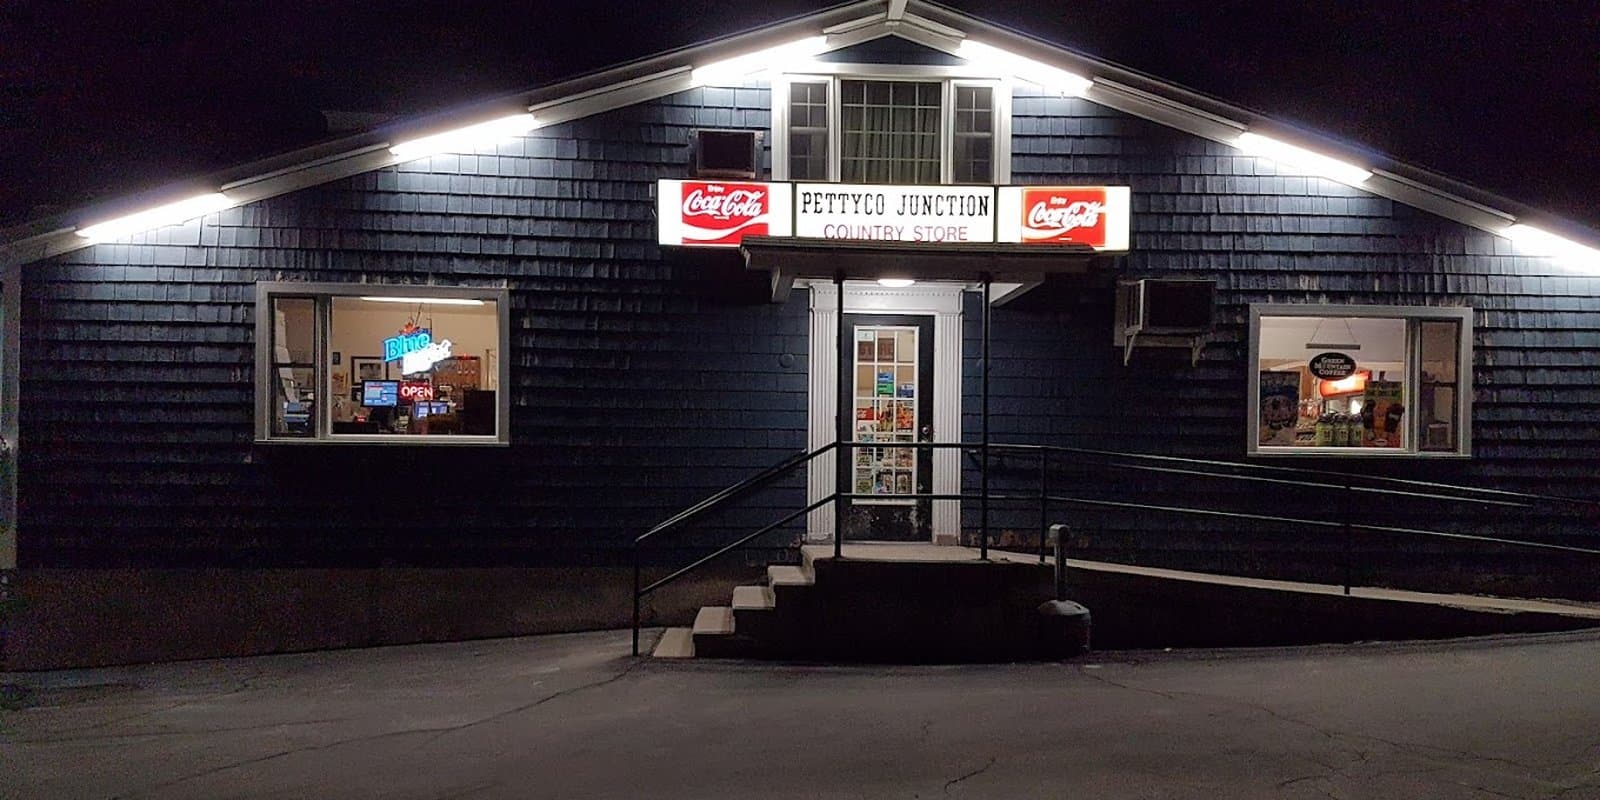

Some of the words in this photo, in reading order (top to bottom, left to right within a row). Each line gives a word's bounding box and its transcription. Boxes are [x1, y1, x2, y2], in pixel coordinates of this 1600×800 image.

[683, 189, 765, 217] Coca-Cola
[801, 191, 885, 216] PETTYCO
[896, 194, 990, 217] JUNCTION
[823, 223, 905, 241] COUNTRY
[913, 225, 968, 243] STORE
[384, 333, 430, 362] Blue
[401, 386, 433, 400] OPEN
